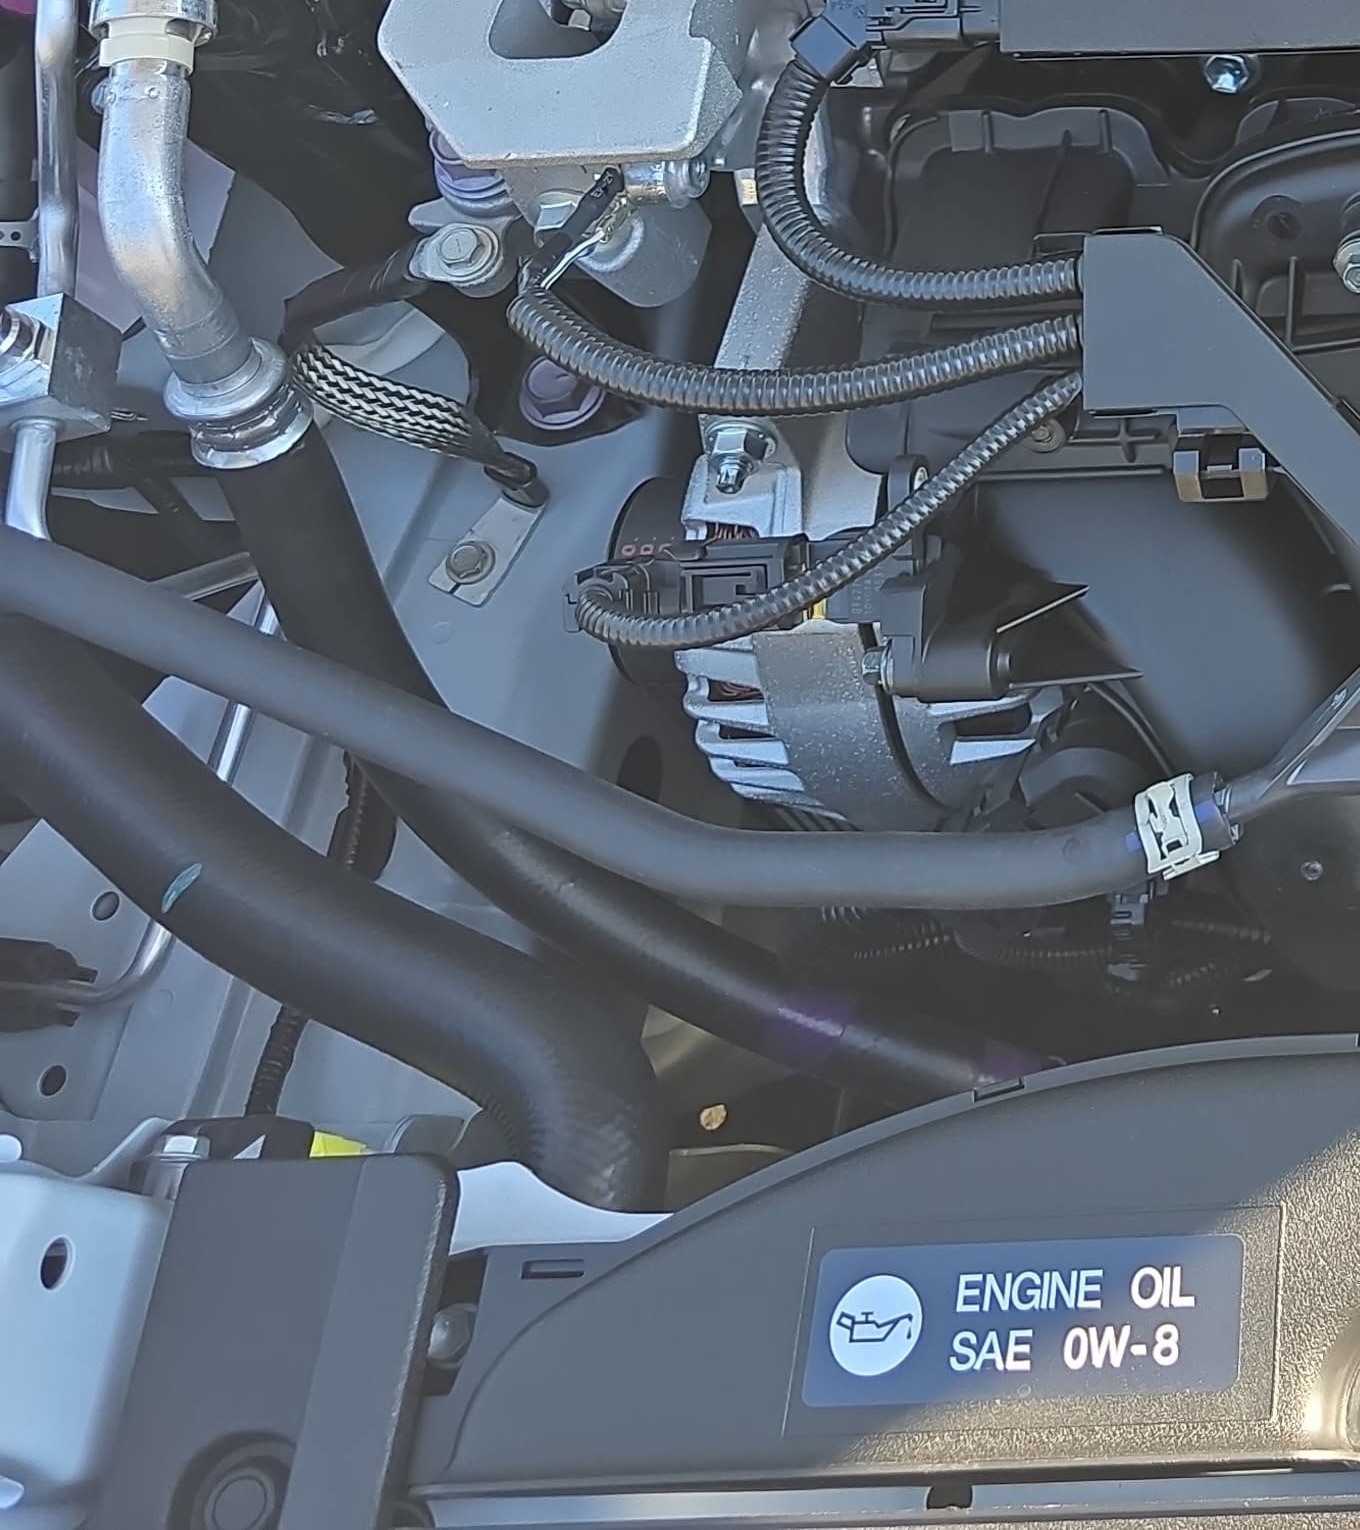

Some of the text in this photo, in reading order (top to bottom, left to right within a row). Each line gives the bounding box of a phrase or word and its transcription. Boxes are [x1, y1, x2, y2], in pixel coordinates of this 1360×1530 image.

[955, 1265, 1195, 1313] ENGINE OIL
[949, 1324, 1180, 1371] SAE 0W-8
